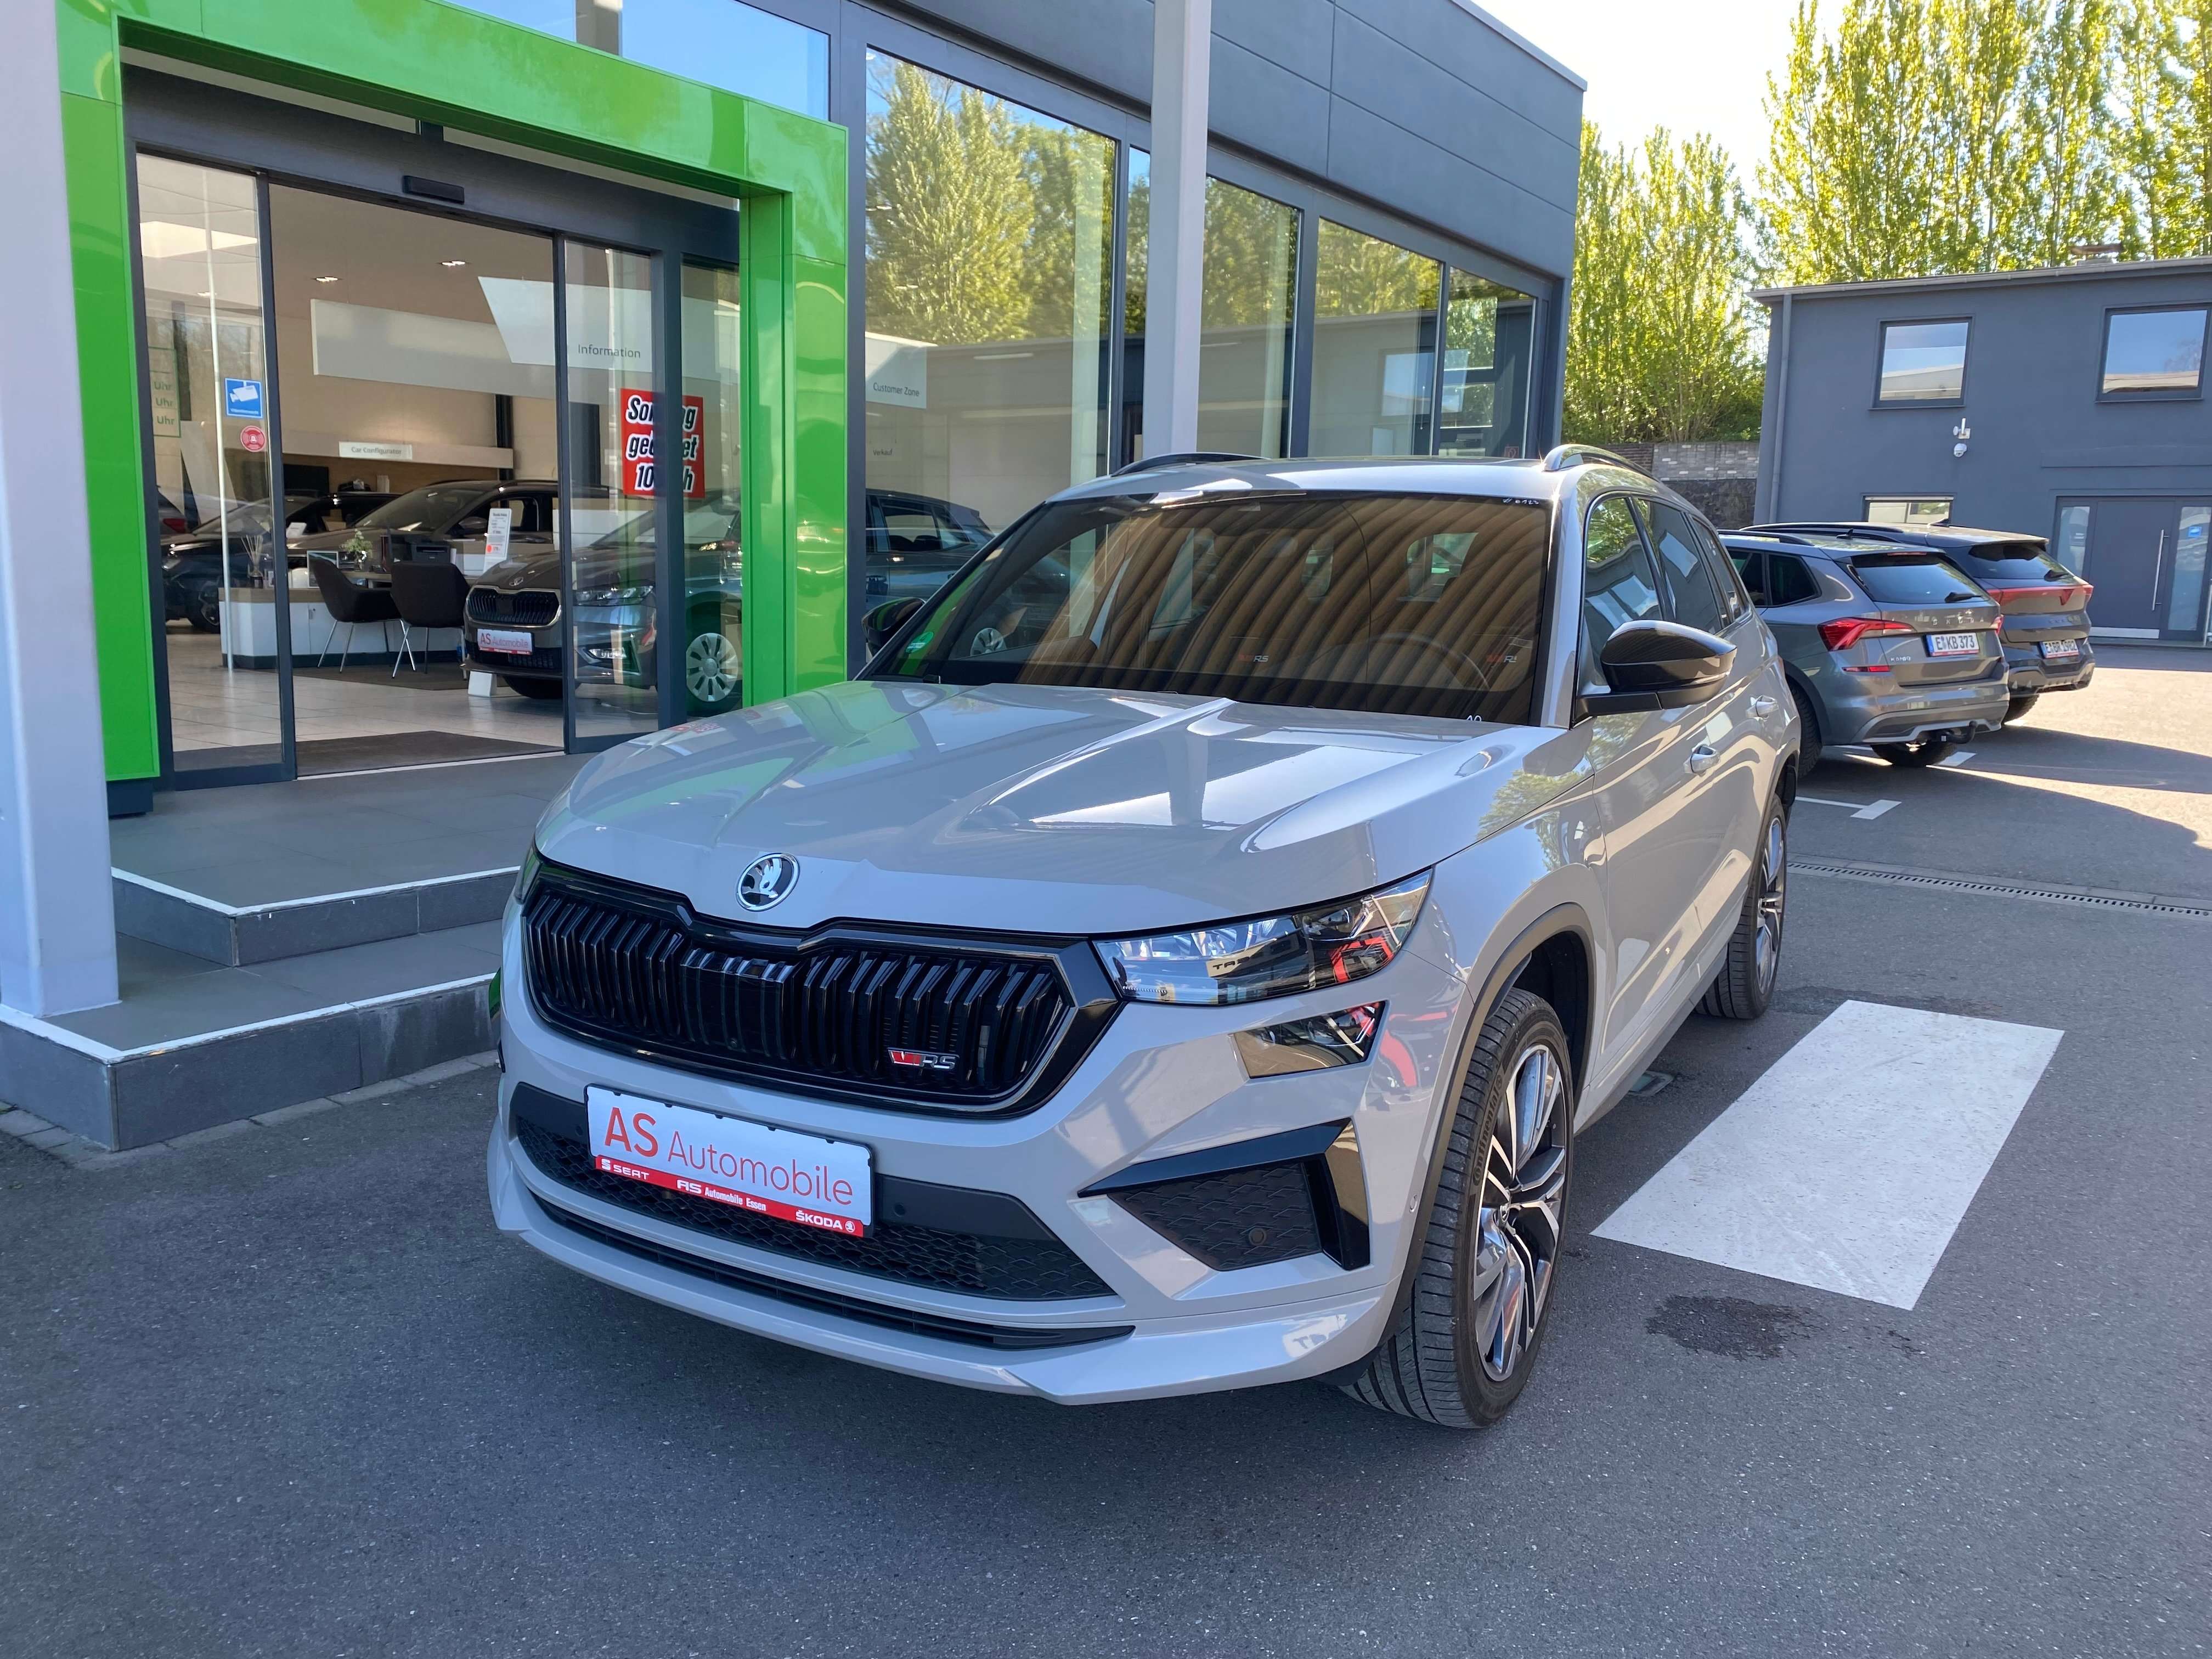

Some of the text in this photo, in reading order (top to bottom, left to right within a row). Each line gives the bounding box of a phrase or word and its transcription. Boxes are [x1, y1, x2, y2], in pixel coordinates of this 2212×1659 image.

[578, 345, 641, 358] Information
[873, 382, 919, 397] Customer Zone
[156, 397, 173, 407] Uhr
[157, 415, 174, 425] Uhr
[481, 633, 528, 647] AS Automobile
[1960, 635, 1975, 648] 373
[605, 1107, 853, 1205] AS Automobile
[613, 1164, 843, 1230] SEAT AS Automobile Essen ŠKODA
